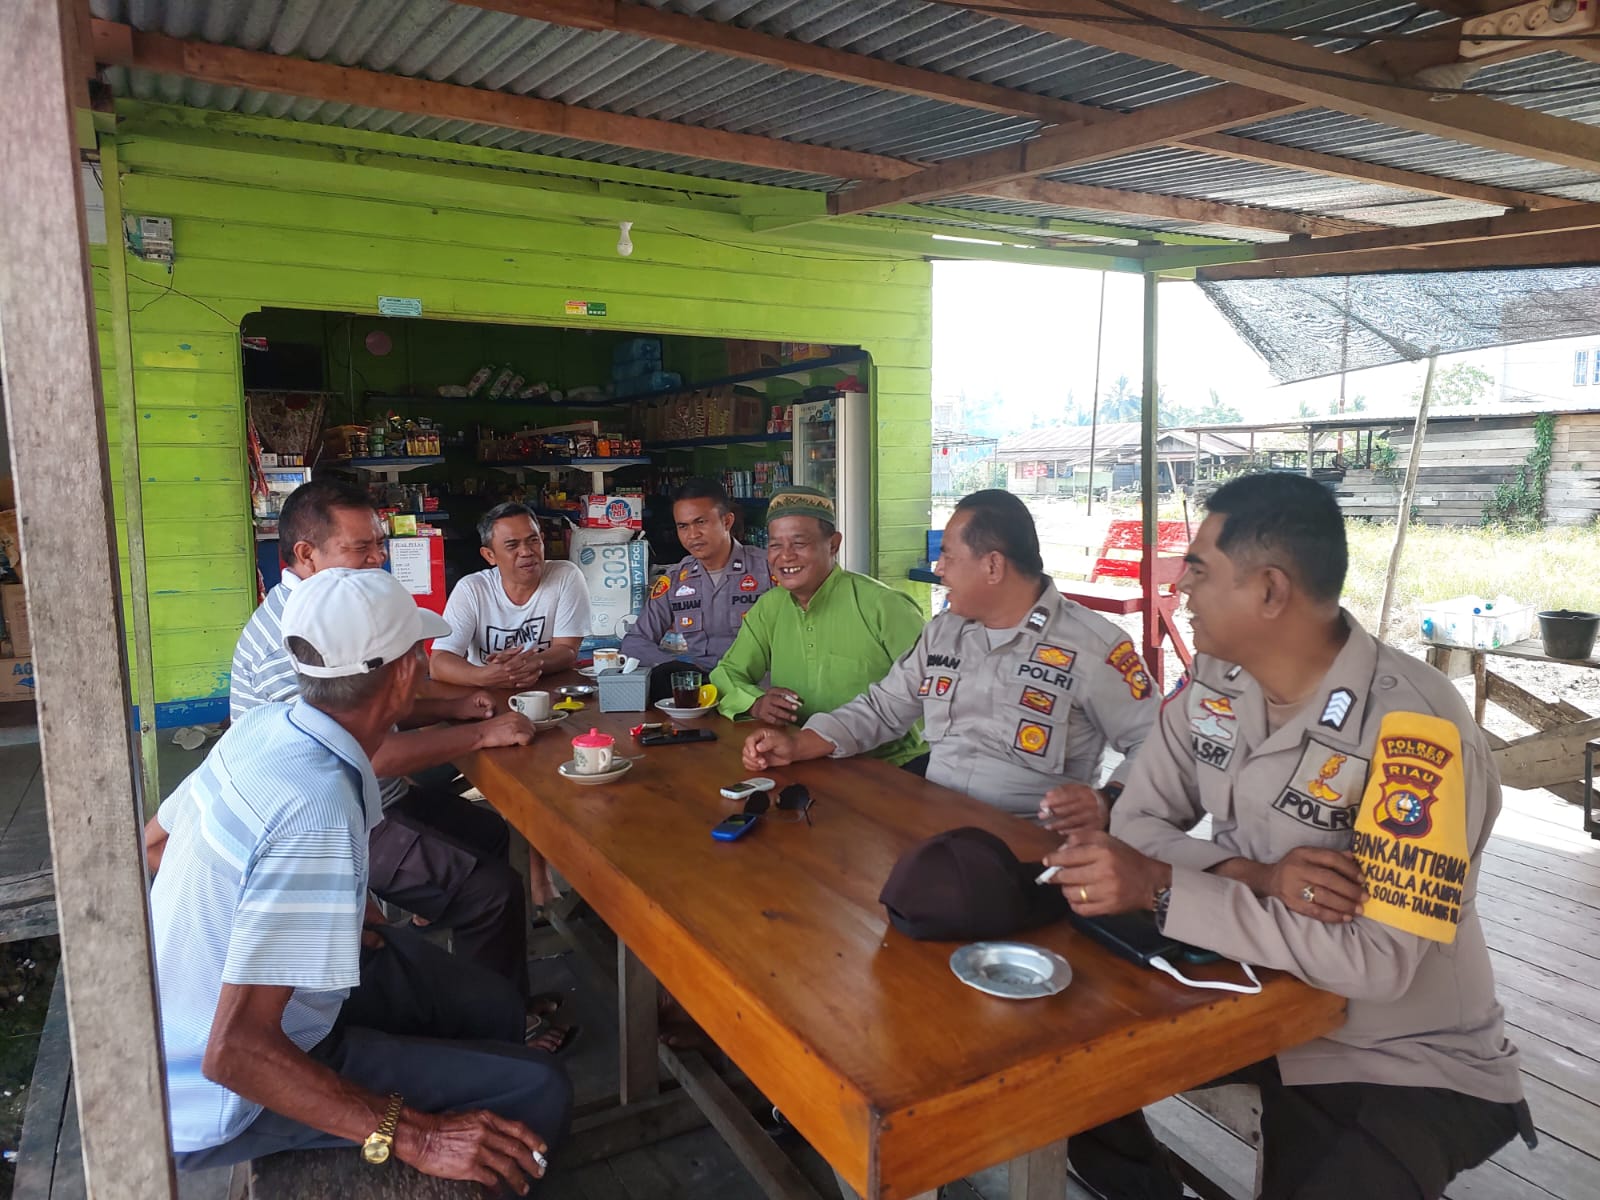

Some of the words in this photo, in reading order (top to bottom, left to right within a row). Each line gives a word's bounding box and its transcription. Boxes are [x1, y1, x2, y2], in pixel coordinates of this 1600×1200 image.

[602, 546, 629, 589] 303
[632, 570, 644, 609] Poultry
[1017, 664, 1074, 691] POLRI
[1387, 738, 1446, 760] POLRES
[1389, 764, 1434, 783] RIAU
[1280, 791, 1357, 830] POLRI
